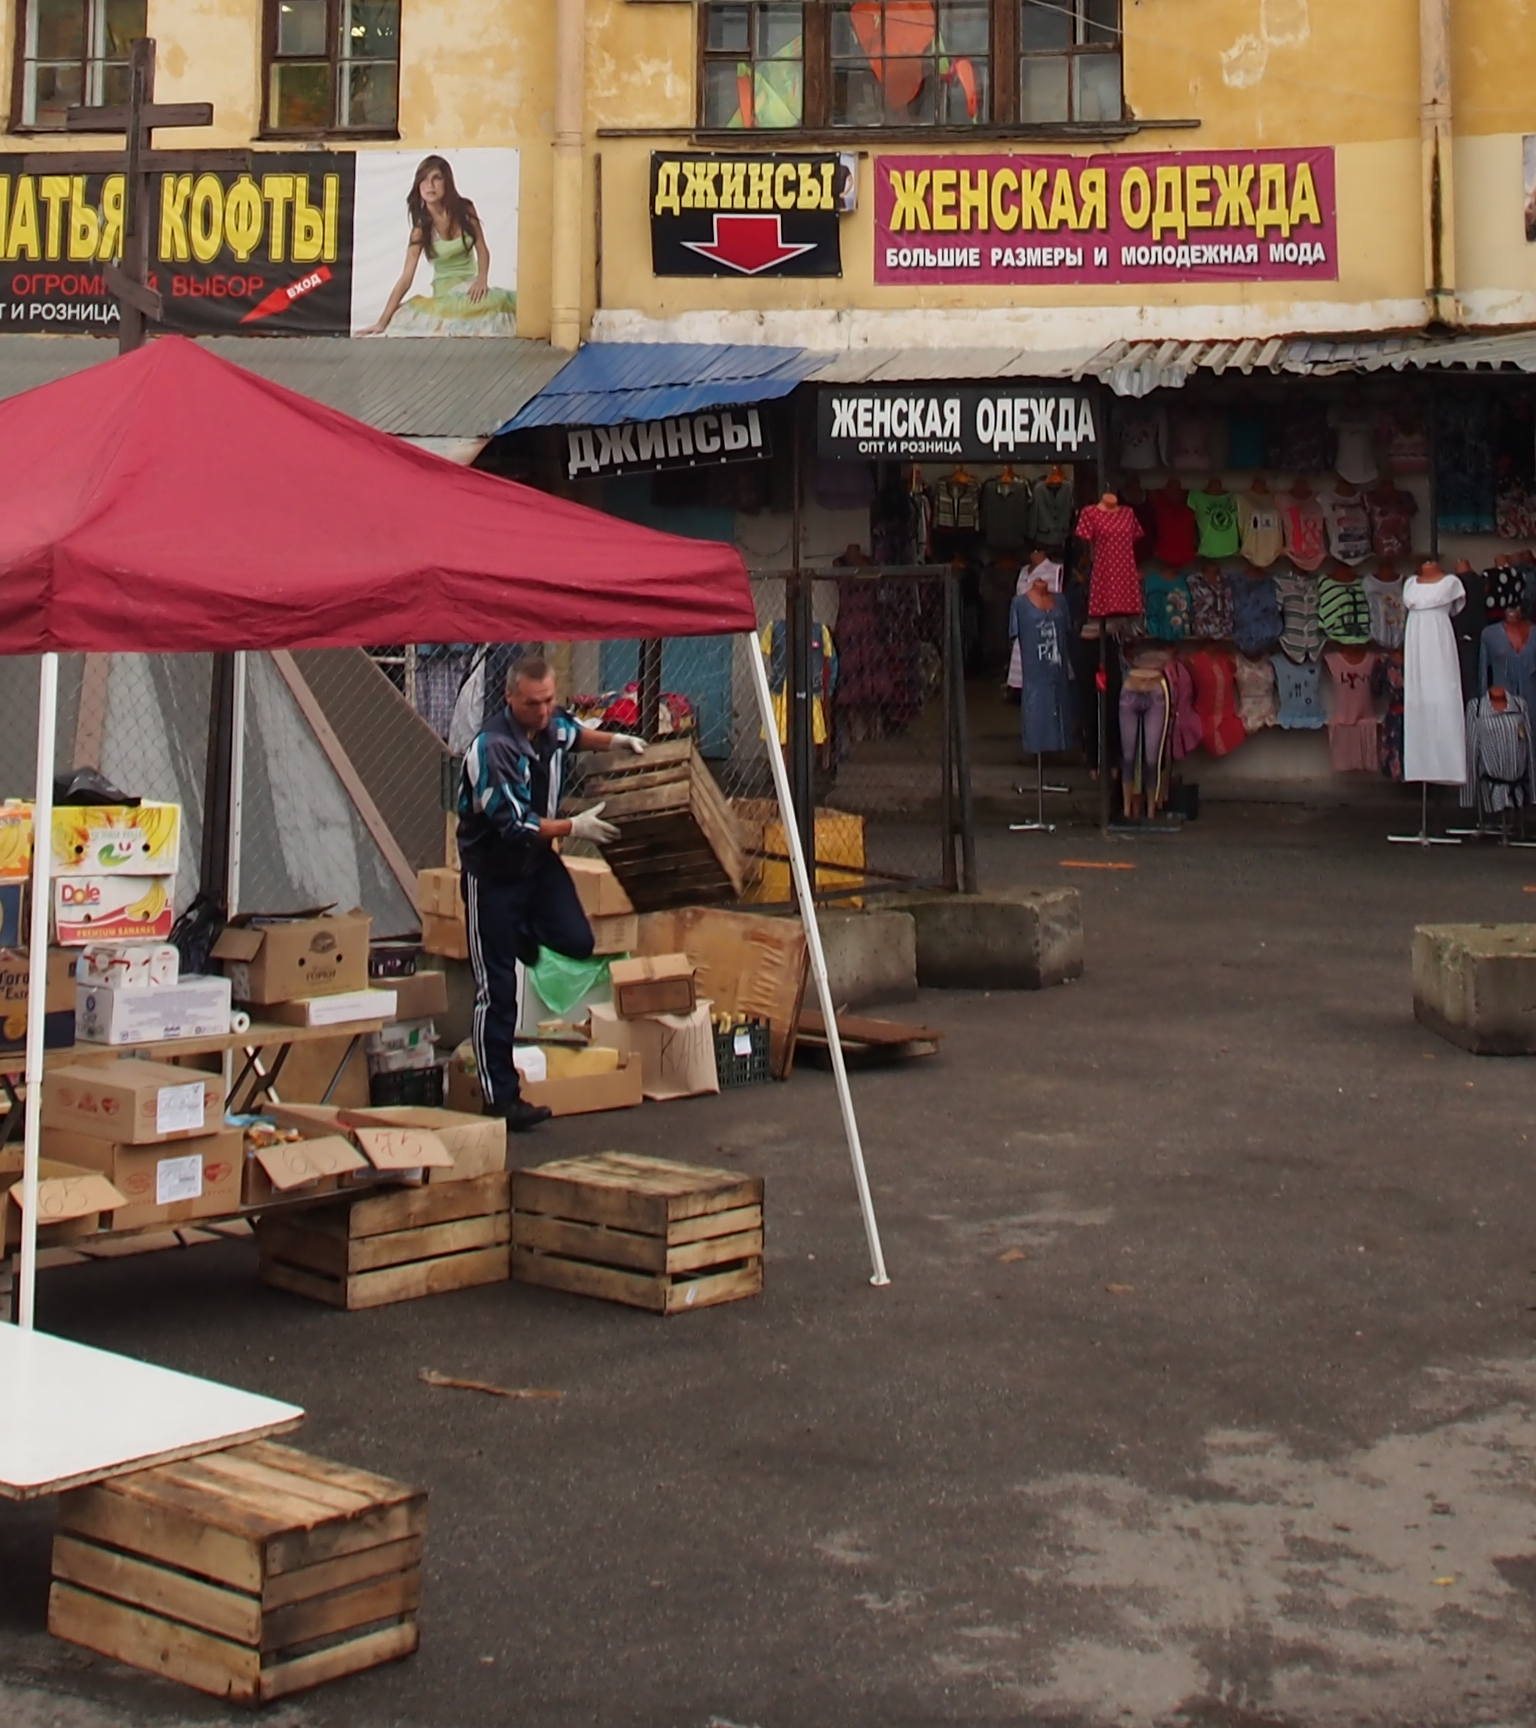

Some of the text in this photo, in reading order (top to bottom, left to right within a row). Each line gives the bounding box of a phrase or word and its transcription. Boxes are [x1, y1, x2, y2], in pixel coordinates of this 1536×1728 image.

[654, 161, 834, 216] ДЖИНСЫ
[889, 163, 1322, 241] ЖЕНСКАЯ ОДЕЖДА
[158, 173, 340, 263] КОФТЫ
[885, 241, 1326, 269] БОЛЬШИЕ РАЗМЕРЫ И МОЛОДЕЖНАЯ МОДА
[172, 275, 265, 298] ВЫБОР
[286, 273, 323, 300] ВХОД
[11, 304, 25, 320] И
[30, 303, 121, 323] РОЗНИЦА
[830, 397, 1097, 452] ЖЕНСКАЯ ОДЕЖДА
[566, 409, 764, 474] ДЖИНСЫ
[857, 440, 963, 455] ОПТ И РОЗНИЦА
[61, 882, 101, 905] Dole
[76, 925, 157, 938] PREMIUM BANANAS
